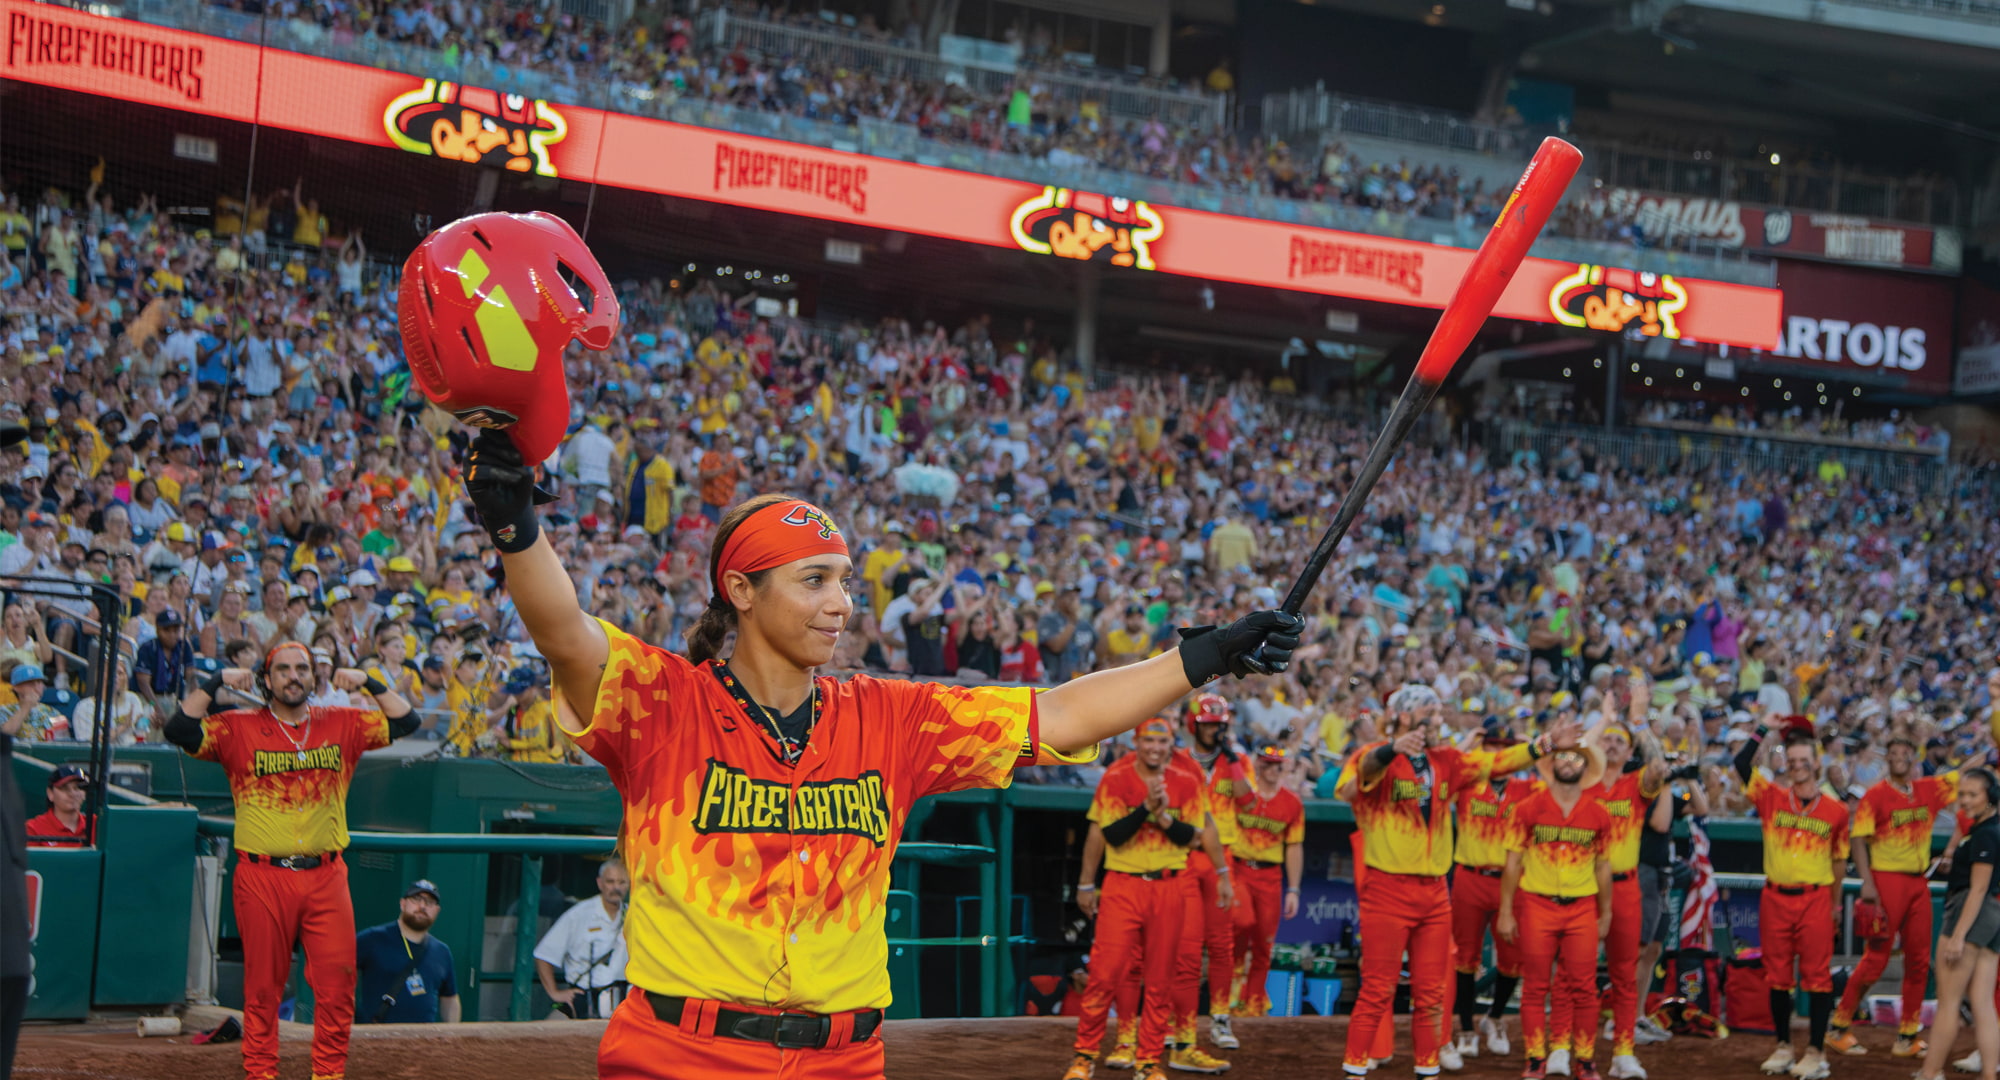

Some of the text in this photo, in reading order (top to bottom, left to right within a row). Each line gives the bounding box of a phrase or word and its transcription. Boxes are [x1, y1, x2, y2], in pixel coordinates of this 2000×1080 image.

[9, 11, 204, 101] FIREFIGHTERS
[714, 142, 868, 214] FIREFIGHTERS
[1305, 895, 1360, 926] xfinity
